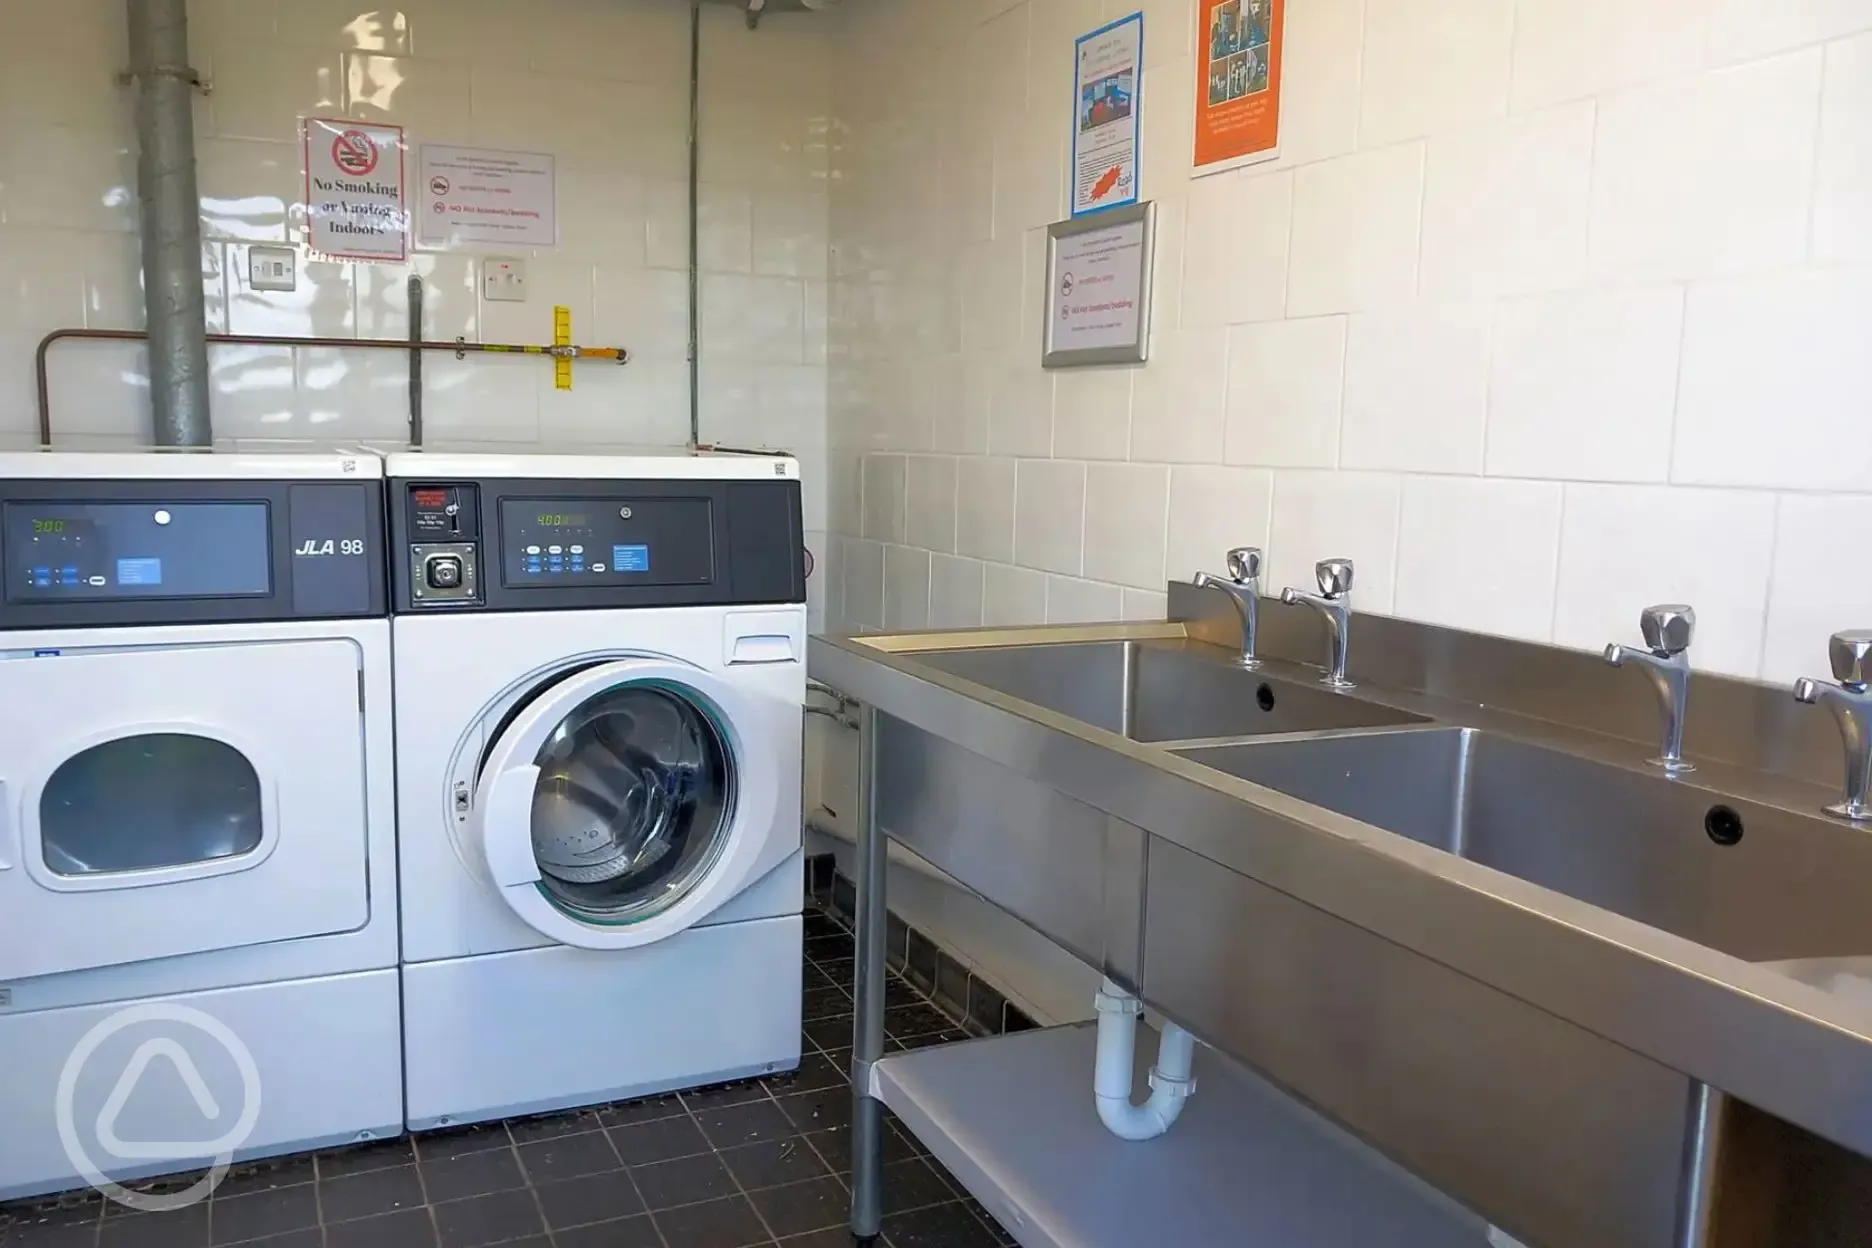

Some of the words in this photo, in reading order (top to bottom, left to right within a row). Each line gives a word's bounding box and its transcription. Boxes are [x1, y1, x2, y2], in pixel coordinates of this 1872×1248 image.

[313, 177, 332, 191] No
[335, 179, 398, 198] Smoking
[322, 202, 338, 213] or
[329, 221, 385, 235] Indoors
[295, 539, 335, 555] JLA
[340, 539, 364, 555] 98
